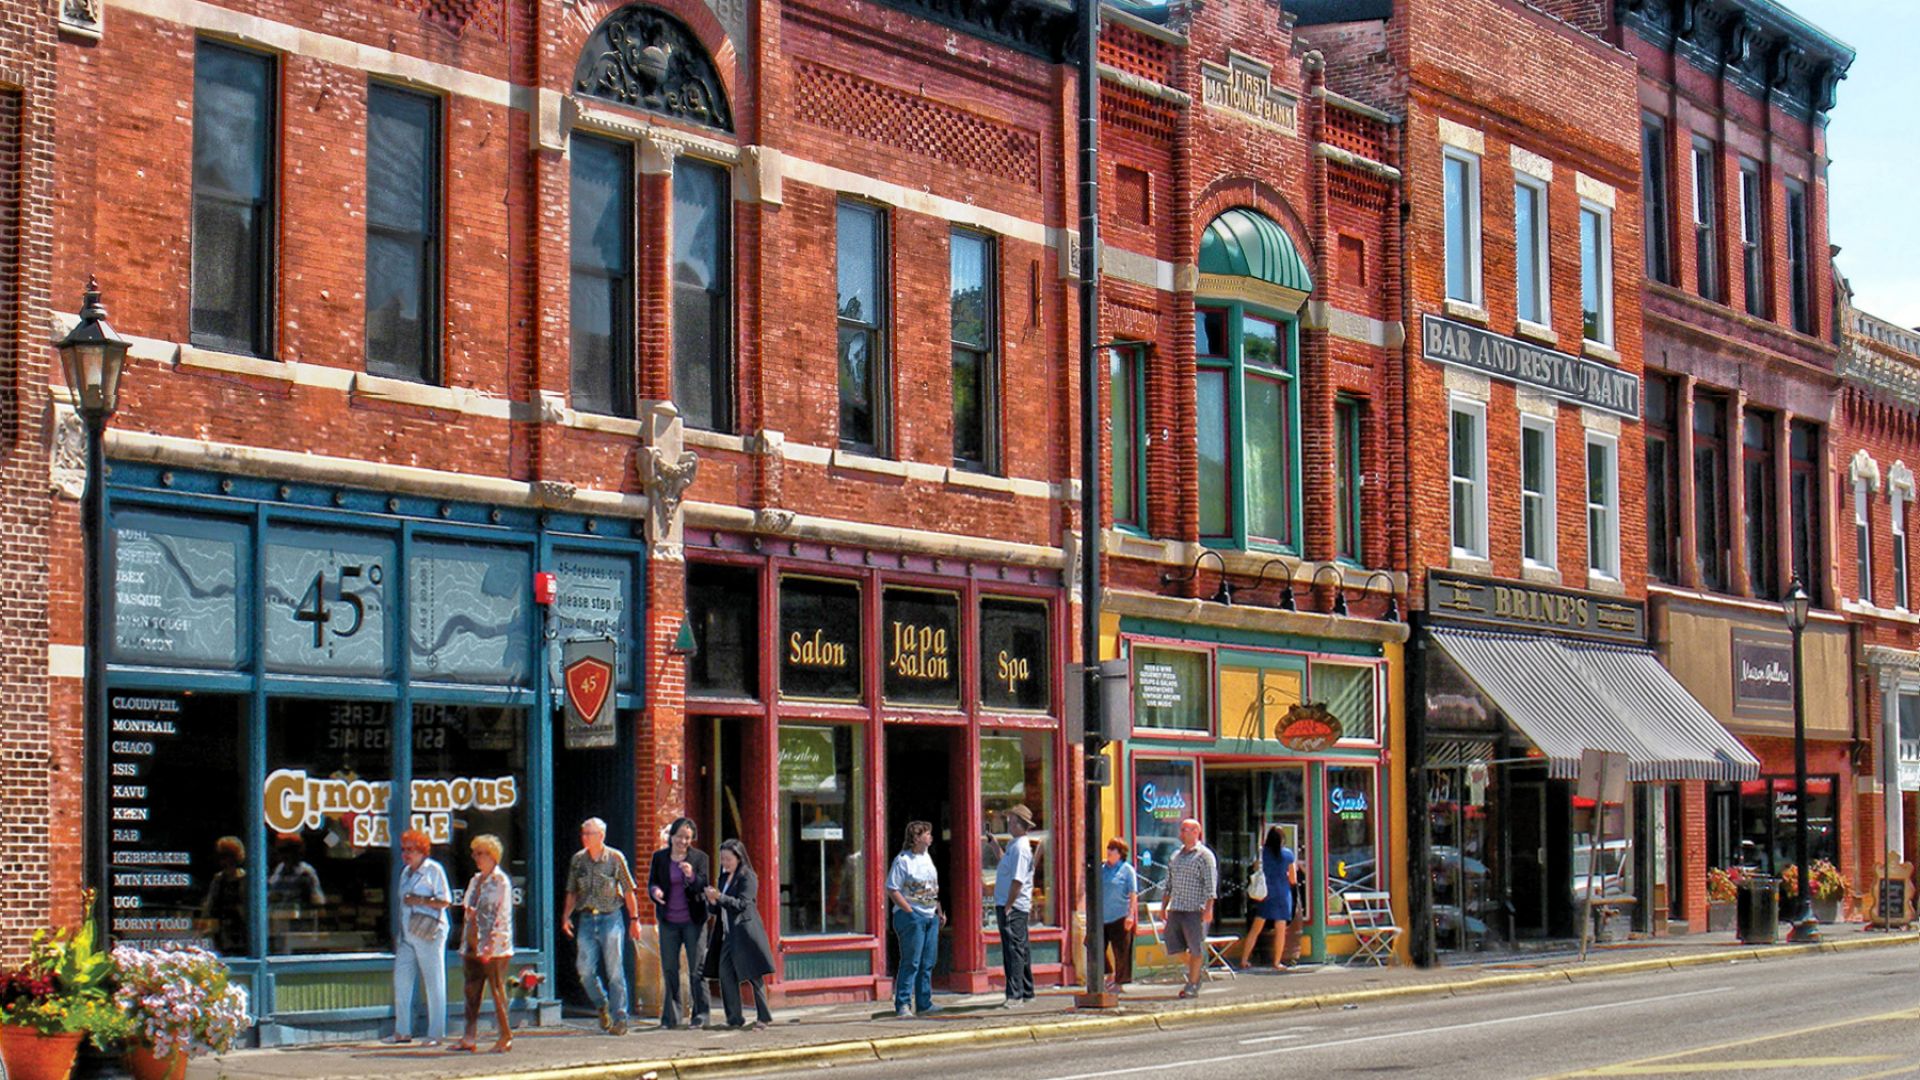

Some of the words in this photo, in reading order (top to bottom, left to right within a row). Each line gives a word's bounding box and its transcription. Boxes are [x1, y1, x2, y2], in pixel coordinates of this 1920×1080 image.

[1234, 69, 1266, 97] FIRST
[1206, 78, 1262, 115] NATIONAL
[1264, 100, 1293, 129] BANK
[1428, 322, 1472, 361] BAR
[1478, 336, 1517, 372] AND
[1518, 347, 1636, 411] RESTAURANT
[116, 592, 162, 607] VASQUE
[294, 564, 383, 648] 45°
[558, 592, 589, 609] please
[591, 595, 612, 612] step
[1494, 586, 1589, 627] BRINE'S
[790, 629, 847, 665] Salon
[890, 621, 948, 669] Japa
[898, 652, 948, 678] salon
[997, 649, 1031, 693] Spa
[112, 697, 179, 712] CLOUDVEIL
[112, 719, 176, 733] MONTRAIL
[112, 741, 153, 754] CHACO
[112, 763, 136, 776] ISIS
[112, 785, 146, 798] KAVU
[112, 807, 147, 820] KEEN
[112, 829, 139, 841] RAB
[112, 851, 190, 865] ICEBREAKER
[113, 873, 141, 887] MTN
[142, 873, 190, 887] KHAKIS
[113, 896, 140, 909] UGG
[112, 917, 157, 931] HORNY
[159, 917, 190, 931] TOAD
